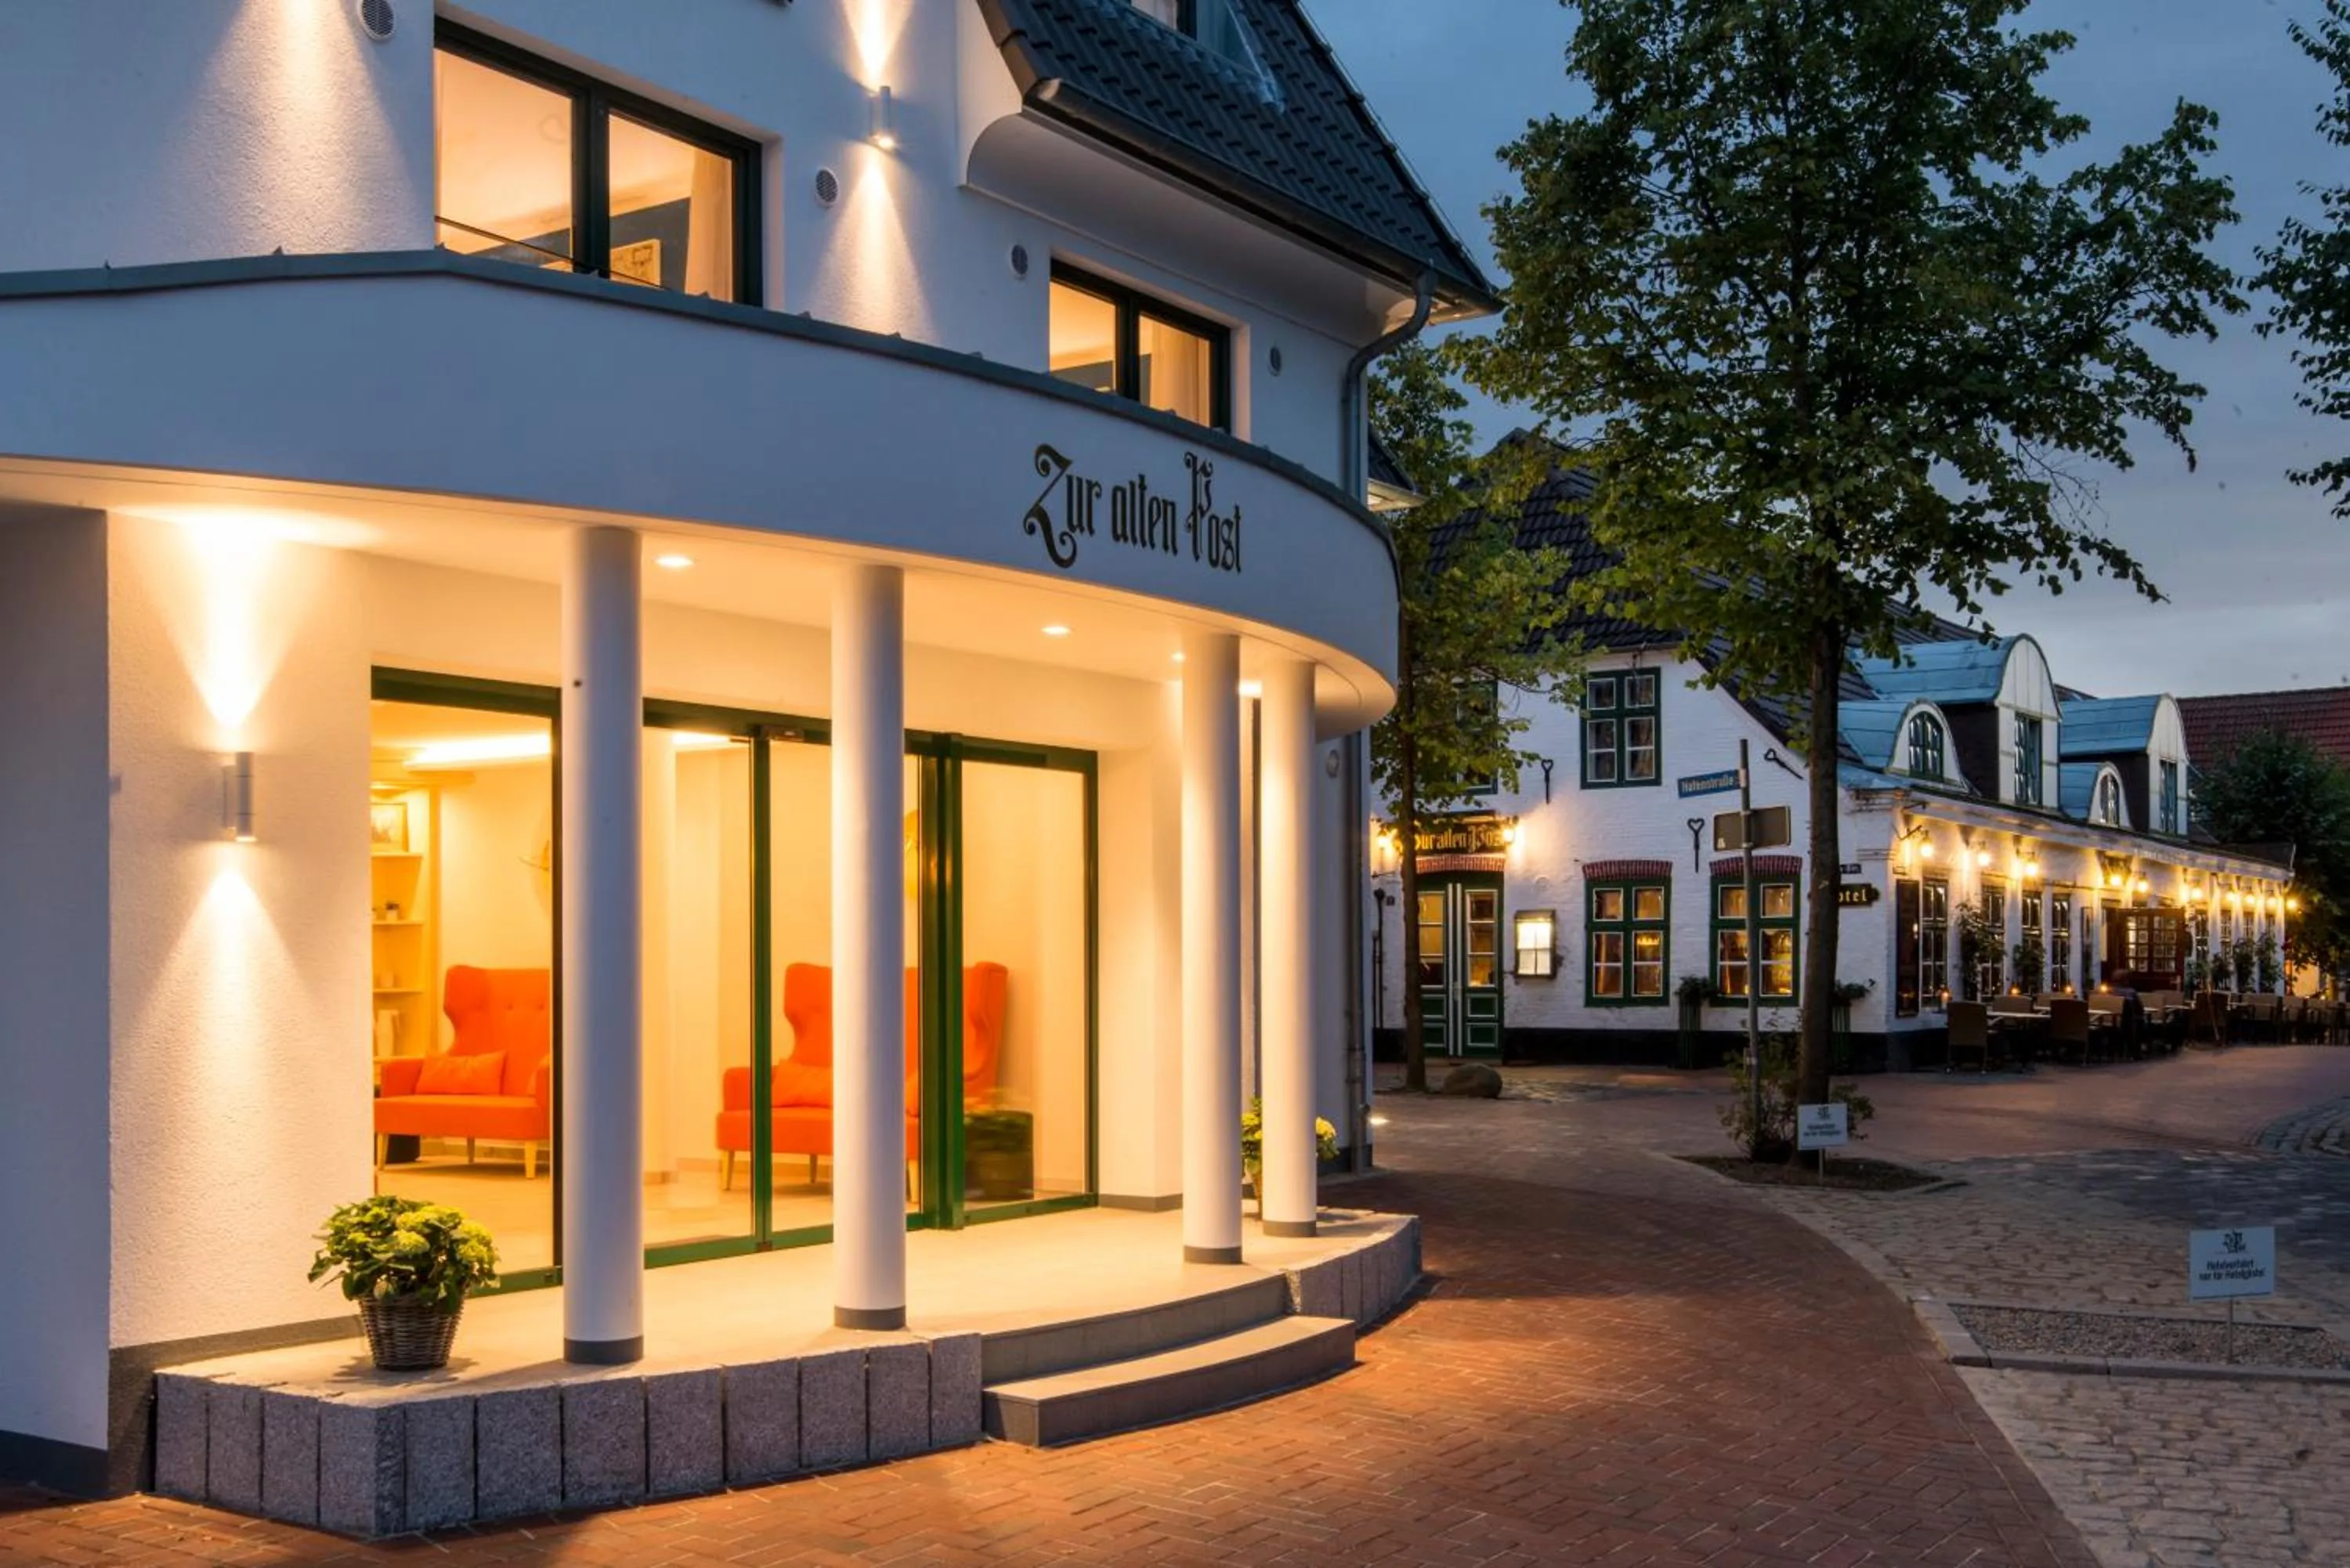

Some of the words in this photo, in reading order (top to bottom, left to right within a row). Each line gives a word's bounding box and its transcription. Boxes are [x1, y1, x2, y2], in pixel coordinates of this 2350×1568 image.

[1023, 443, 1102, 569] Zur
[1112, 474, 1178, 556] alten
[1184, 451, 1242, 573] Post
[1838, 889, 1867, 902] otel
